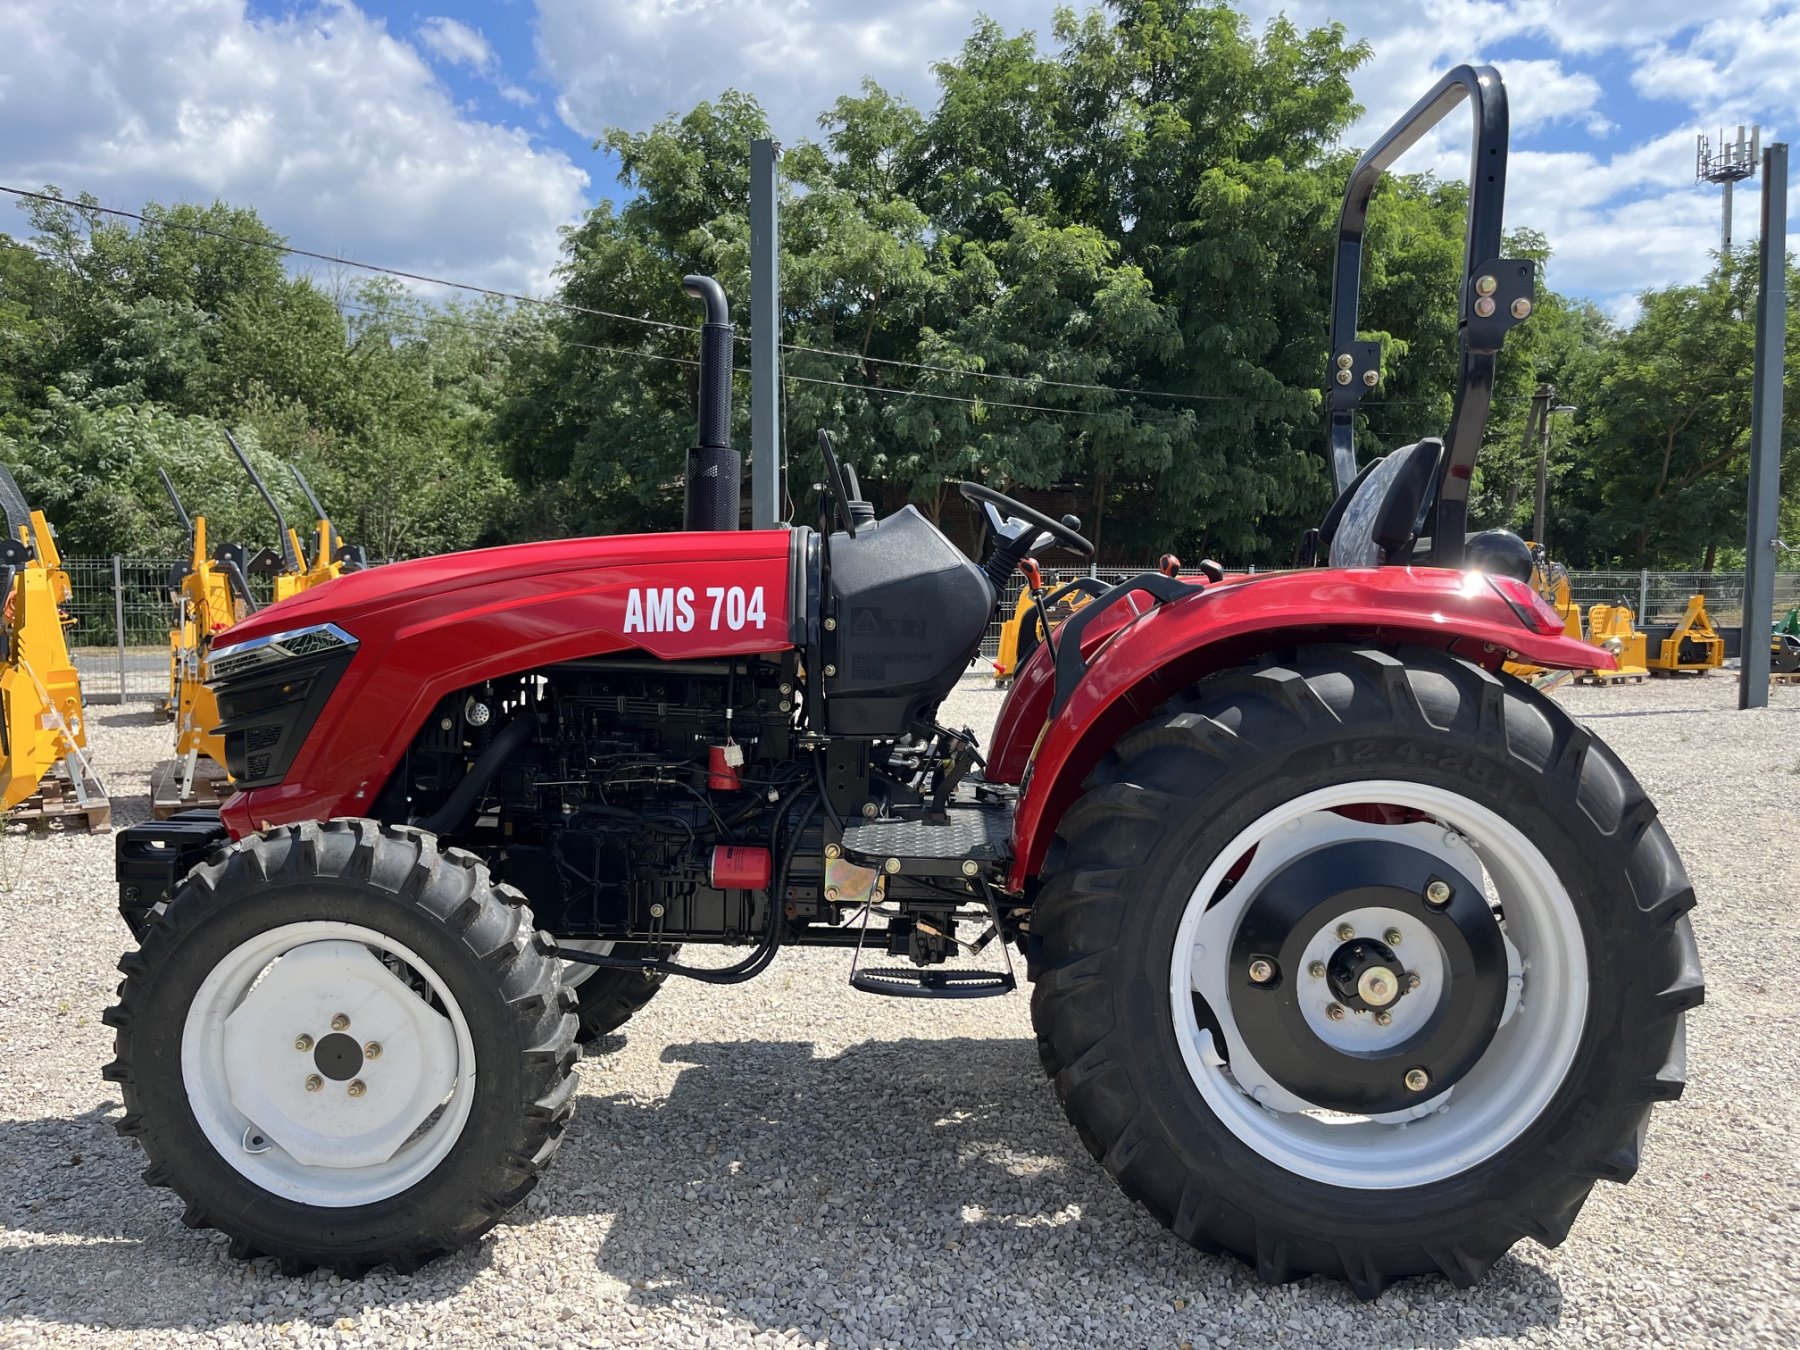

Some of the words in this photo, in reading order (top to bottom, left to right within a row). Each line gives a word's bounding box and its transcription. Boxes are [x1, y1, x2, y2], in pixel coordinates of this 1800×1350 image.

[623, 586, 695, 633] AMS
[706, 585, 767, 631] 704
[1332, 741, 1488, 778] 12.4-28
